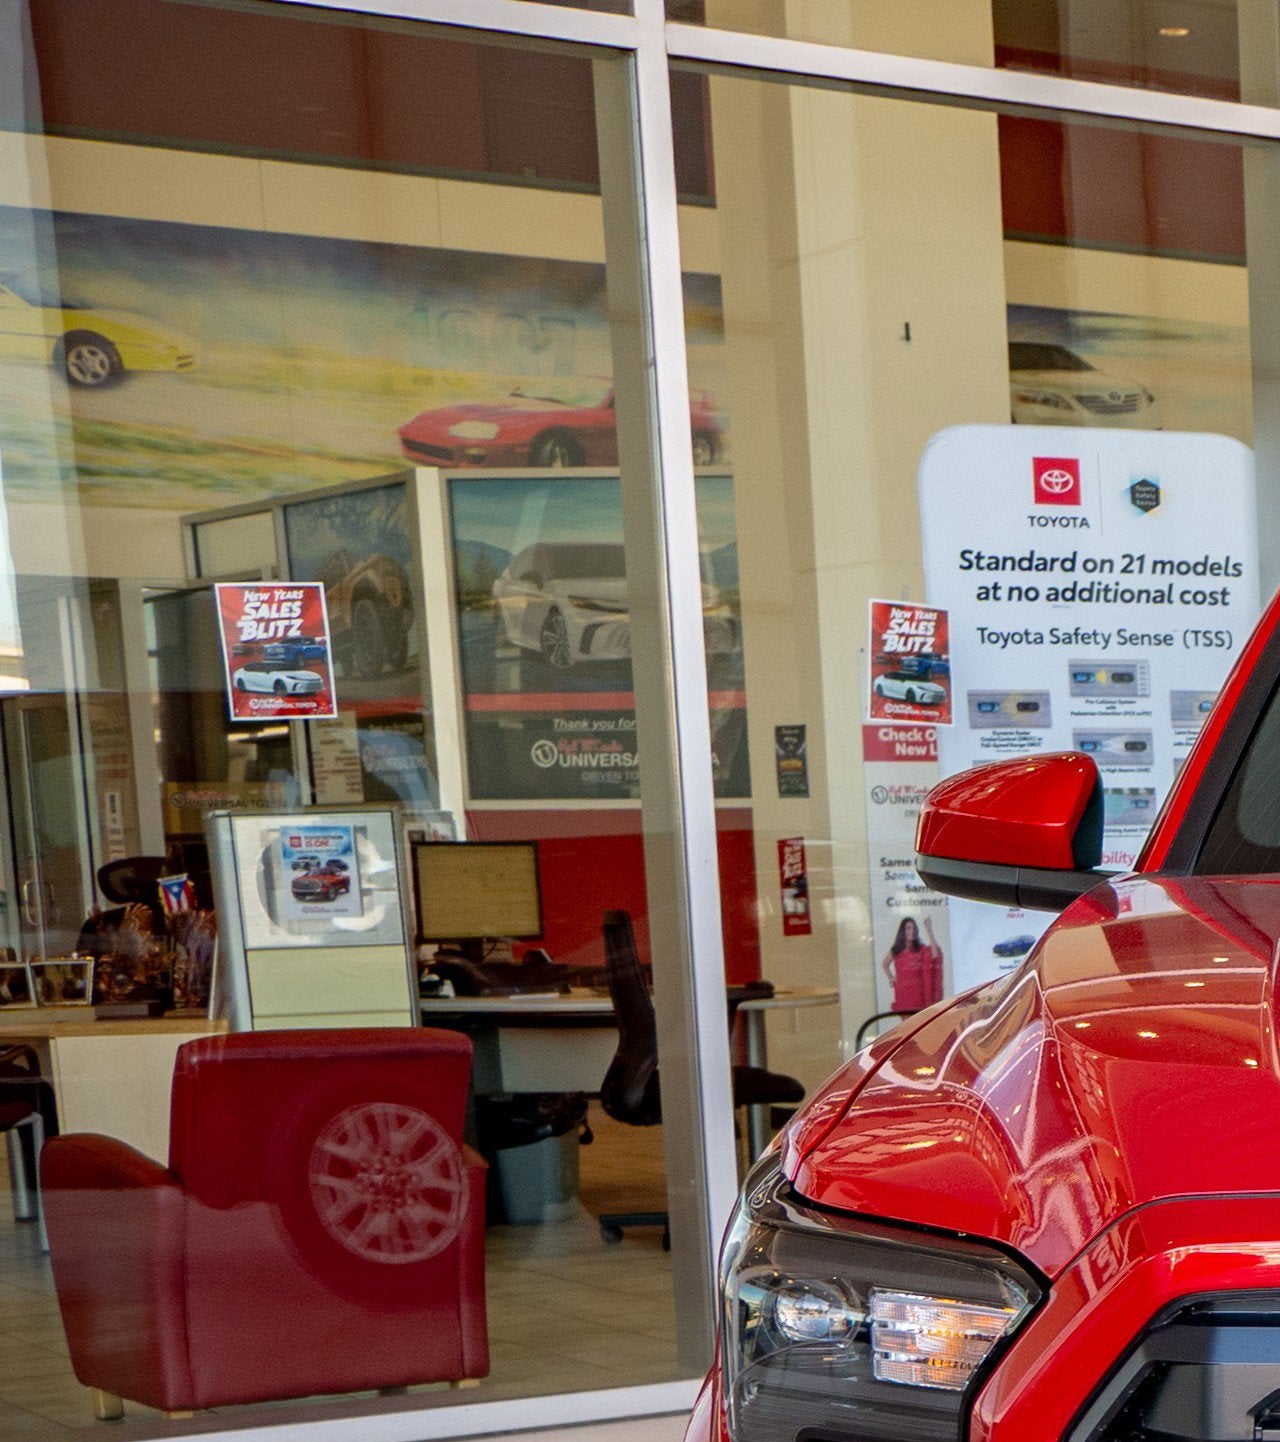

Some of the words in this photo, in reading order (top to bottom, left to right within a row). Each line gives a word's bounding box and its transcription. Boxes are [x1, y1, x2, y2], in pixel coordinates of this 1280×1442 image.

[1027, 515, 1090, 529] TOYOTA
[958, 549, 1078, 574] Standard
[1082, 557, 1115, 574] on
[1119, 553, 1146, 575] 21
[1151, 555, 1243, 578] models
[975, 583, 1003, 602] at
[1007, 585, 1040, 603] no
[1045, 581, 1174, 605] additional
[1179, 586, 1230, 606] cost
[240, 601, 303, 621] SALES
[236, 618, 305, 642] BLITZ
[886, 619, 936, 636] SALES
[882, 633, 936, 653] BLITZ
[977, 627, 1045, 648] Toyota
[1049, 627, 1112, 650] Safety
[1182, 629, 1233, 650] (TSS)
[553, 718, 591, 730] Thank
[592, 719, 616, 732] you
[618, 718, 636, 730] for
[879, 728, 922, 742] Check
[895, 742, 926, 755] New
[559, 753, 640, 768] UNIVERSA
[880, 857, 911, 867] Same
[905, 884, 931, 893] Sam
